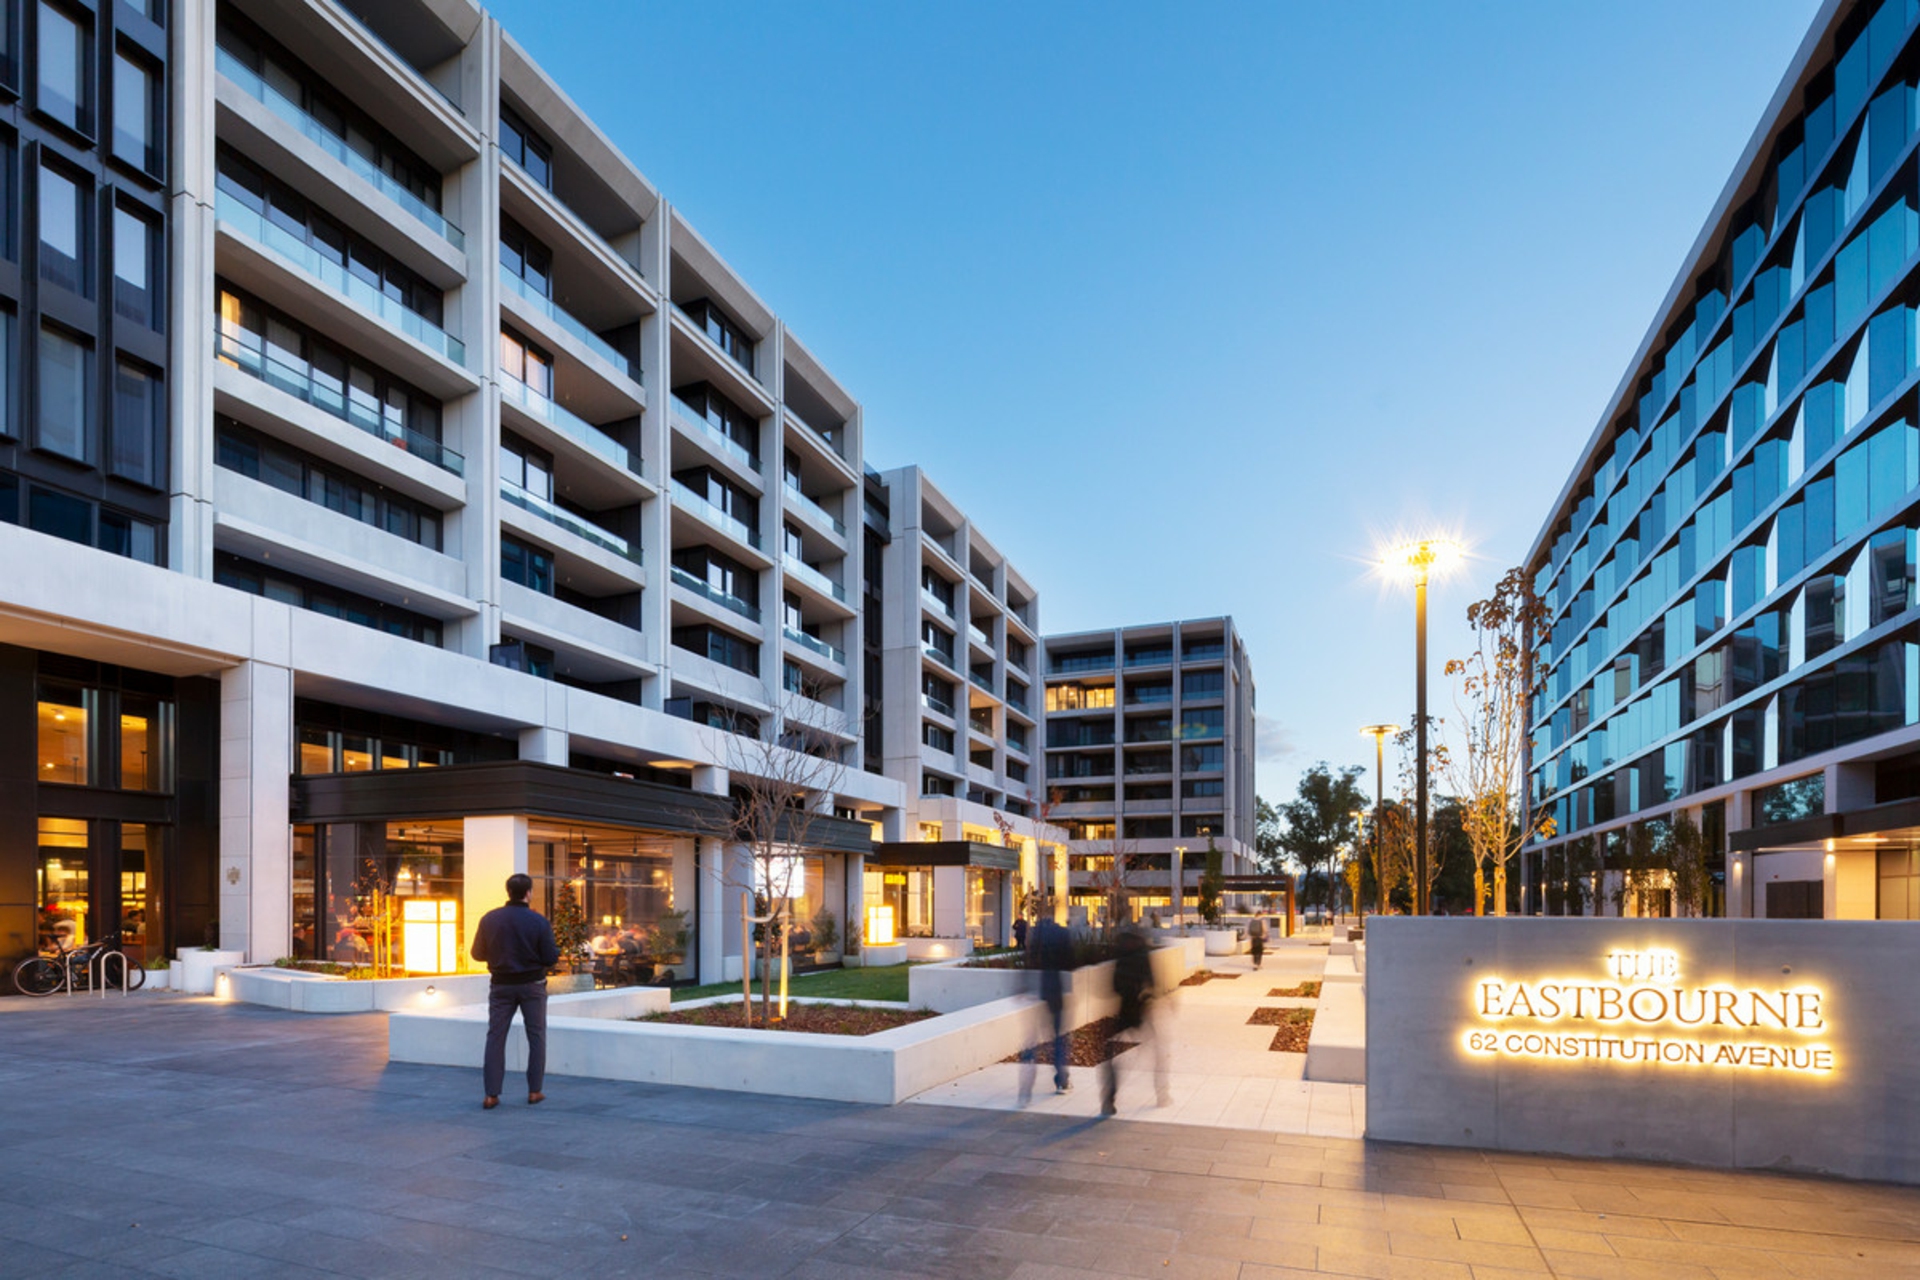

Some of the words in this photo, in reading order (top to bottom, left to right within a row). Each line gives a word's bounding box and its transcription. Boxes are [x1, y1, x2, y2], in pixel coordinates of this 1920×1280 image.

[1604, 954, 1676, 976] THE
[1481, 983, 1823, 1028] EASTBOURNE
[1470, 1033, 1498, 1051] 62
[1505, 1034, 1704, 1063] CONSTITUTION
[1714, 1044, 1833, 1070] AVENUE
